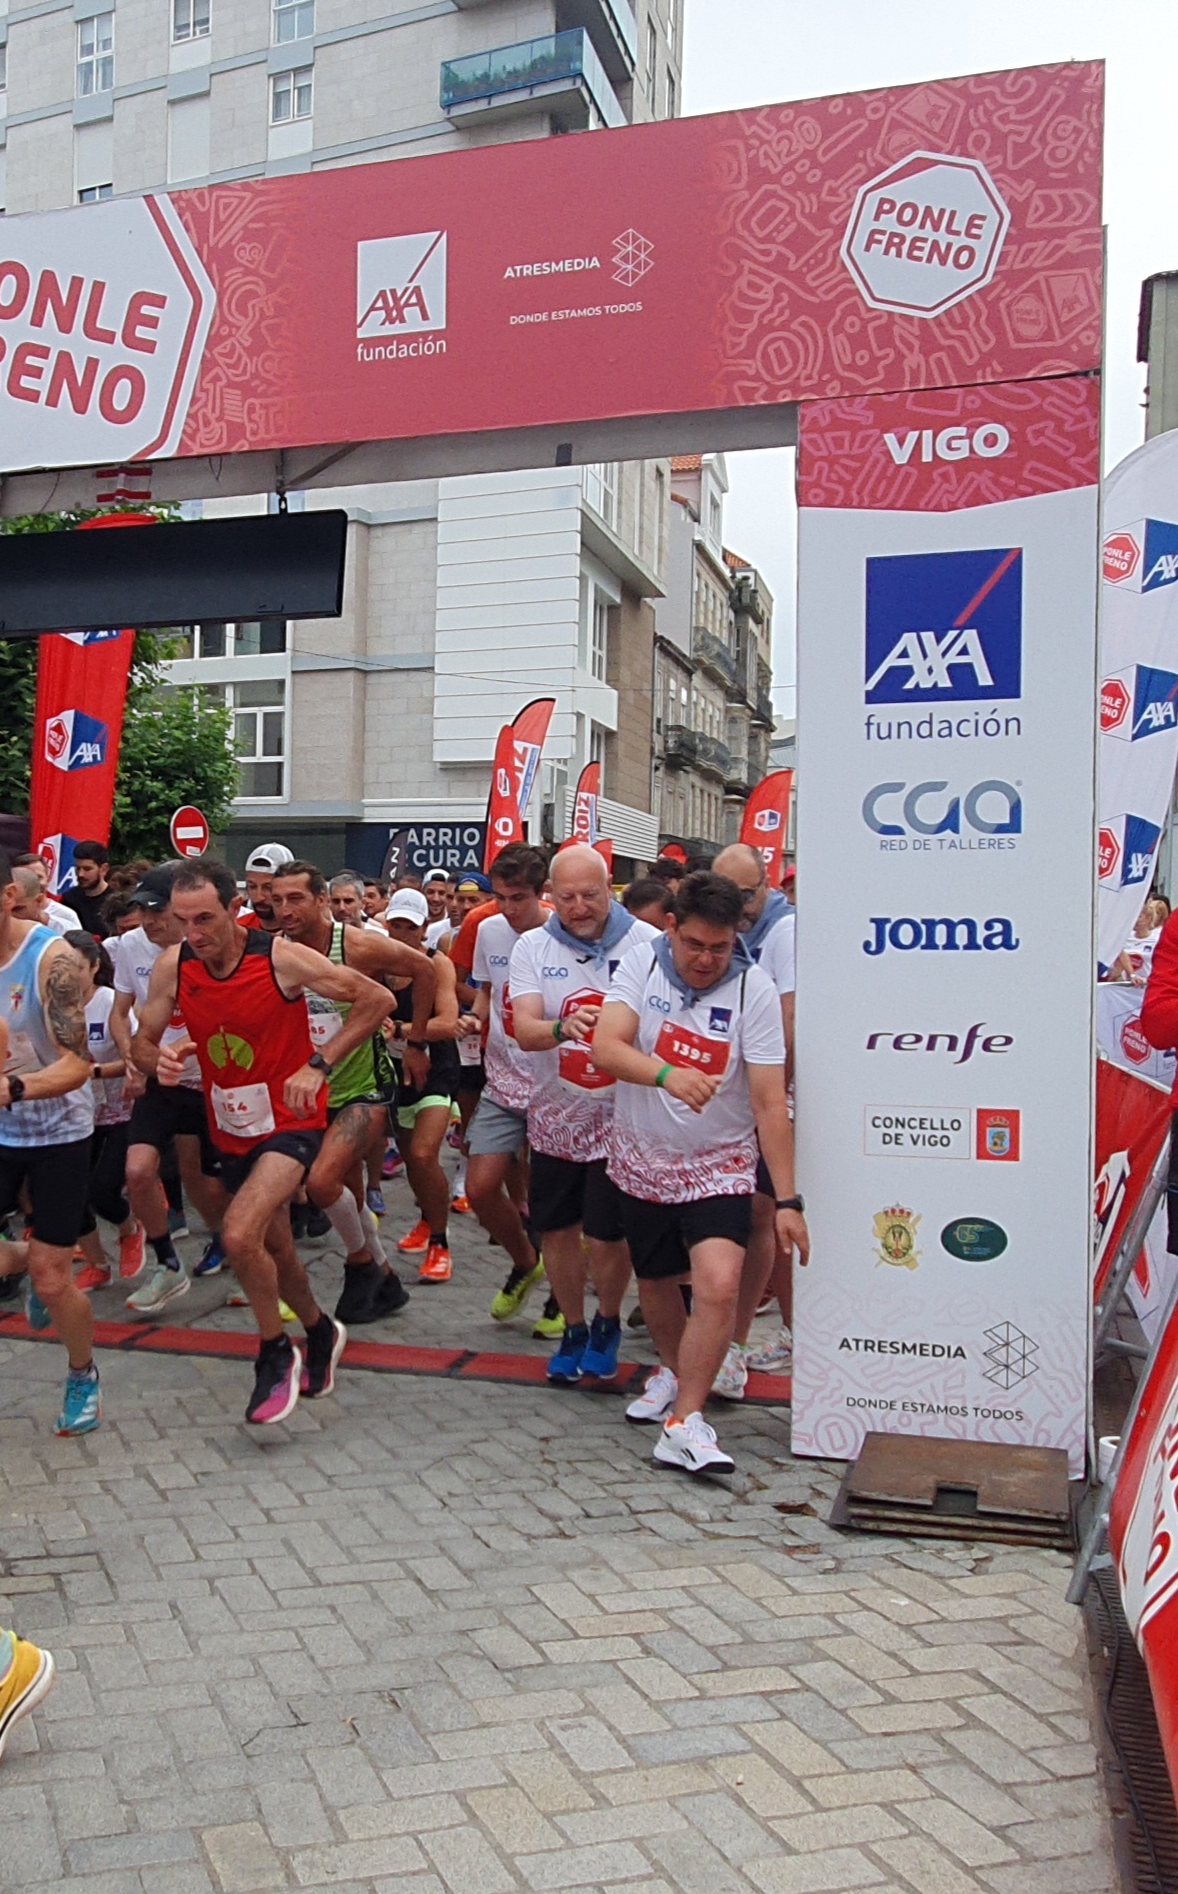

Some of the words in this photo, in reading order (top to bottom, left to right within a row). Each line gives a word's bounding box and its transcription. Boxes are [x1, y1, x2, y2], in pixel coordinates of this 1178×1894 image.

[873, 197, 987, 241] PONLE
[864, 229, 976, 270] FRENO
[503, 257, 600, 279] ATRESMEDIA
[357, 285, 430, 328] AXA
[510, 312, 549, 325] DONDE
[551, 307, 602, 320] ESTAMOS
[604, 302, 642, 316] TODOS
[357, 336, 447, 362] fundación
[884, 423, 1009, 465] VIGO
[865, 628, 994, 691] AXA
[865, 708, 1021, 740] fundación
[1132, 701, 1175, 734] AXA
[68, 742, 101, 766] AXA
[389, 828, 480, 846] ARRIO
[880, 838, 908, 851] RED
[913, 838, 932, 851] DE
[937, 837, 1016, 850] TALLERES
[412, 848, 479, 867] CURA
[673, 1040, 713, 1064] 1395
[866, 1022, 1014, 1065] renfe
[872, 1116, 962, 1131] CONCELLO
[882, 1132, 904, 1146] DE
[909, 1134, 951, 1148] VIGO
[839, 1337, 967, 1359] ATRESMEDIA
[846, 1396, 897, 1411] DONDE
[902, 1401, 969, 1417] ESTAMOS
[974, 1407, 1024, 1421] TODOS
